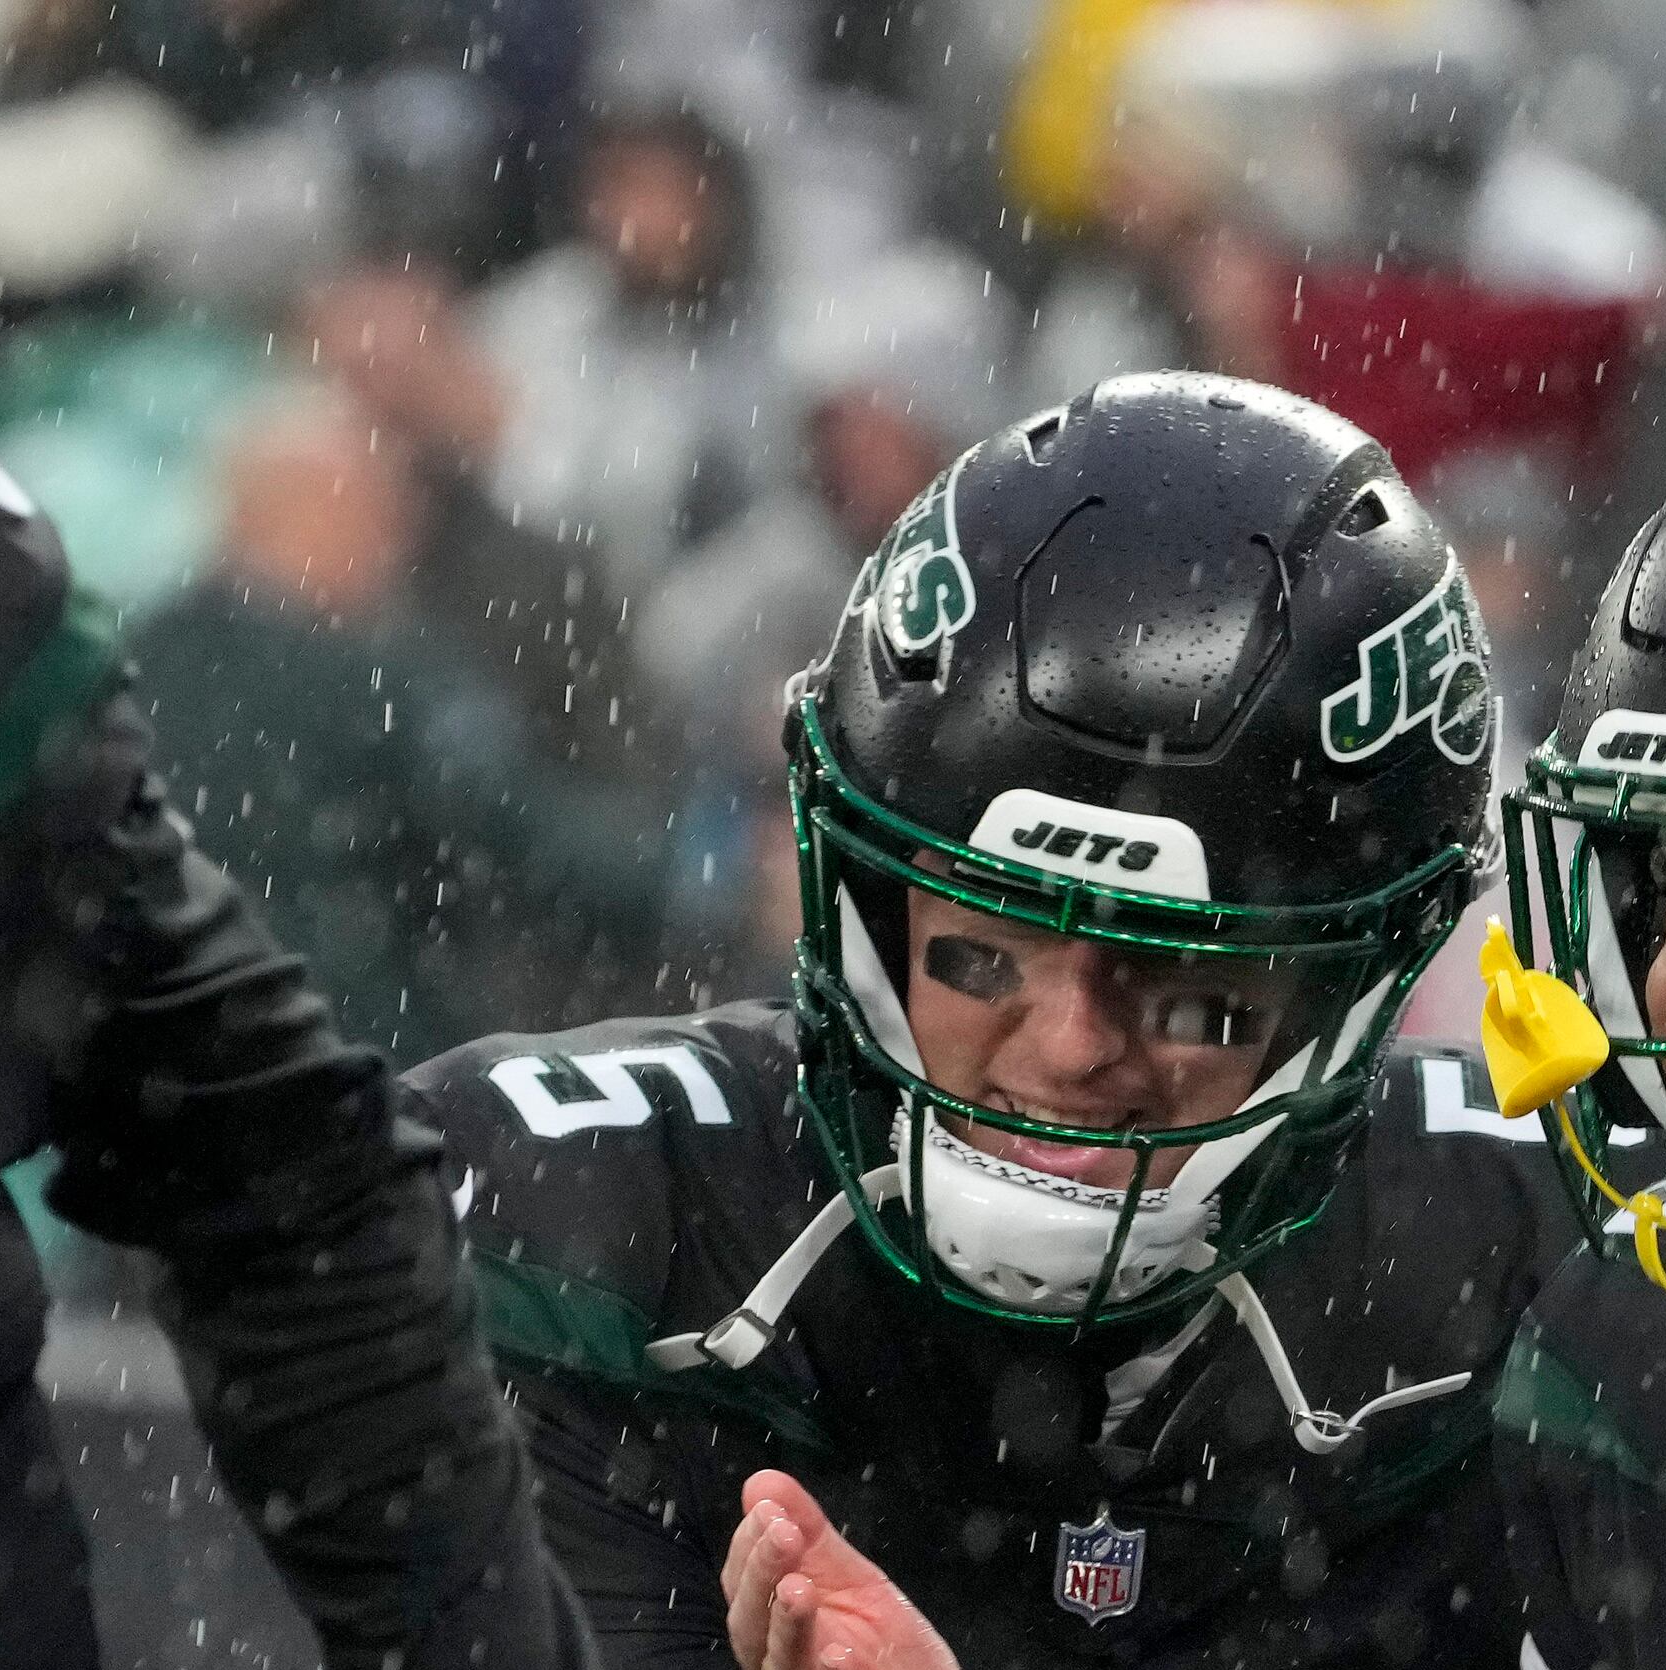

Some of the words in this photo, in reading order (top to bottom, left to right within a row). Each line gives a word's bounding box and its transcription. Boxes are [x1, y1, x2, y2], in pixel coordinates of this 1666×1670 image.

[1011, 820, 1160, 872] JETS
[487, 1045, 733, 1139] 5
[1069, 1564, 1127, 1606] NFL
